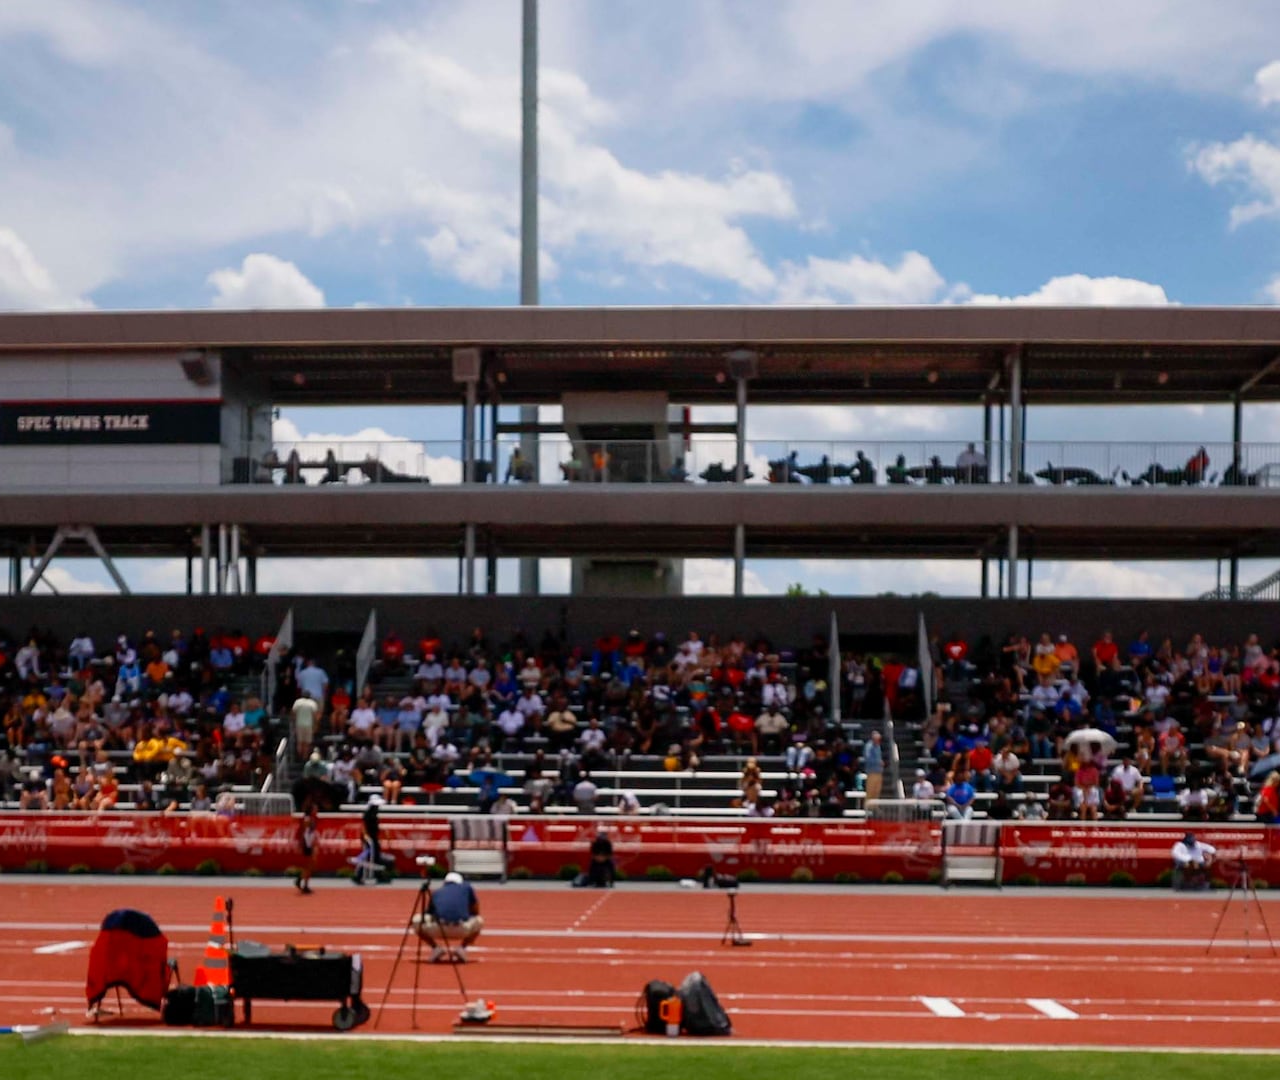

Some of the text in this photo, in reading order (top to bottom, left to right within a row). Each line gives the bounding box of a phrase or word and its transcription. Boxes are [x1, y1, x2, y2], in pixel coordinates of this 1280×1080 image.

[17, 415, 149, 431] SPEC TOWNS TRACK
